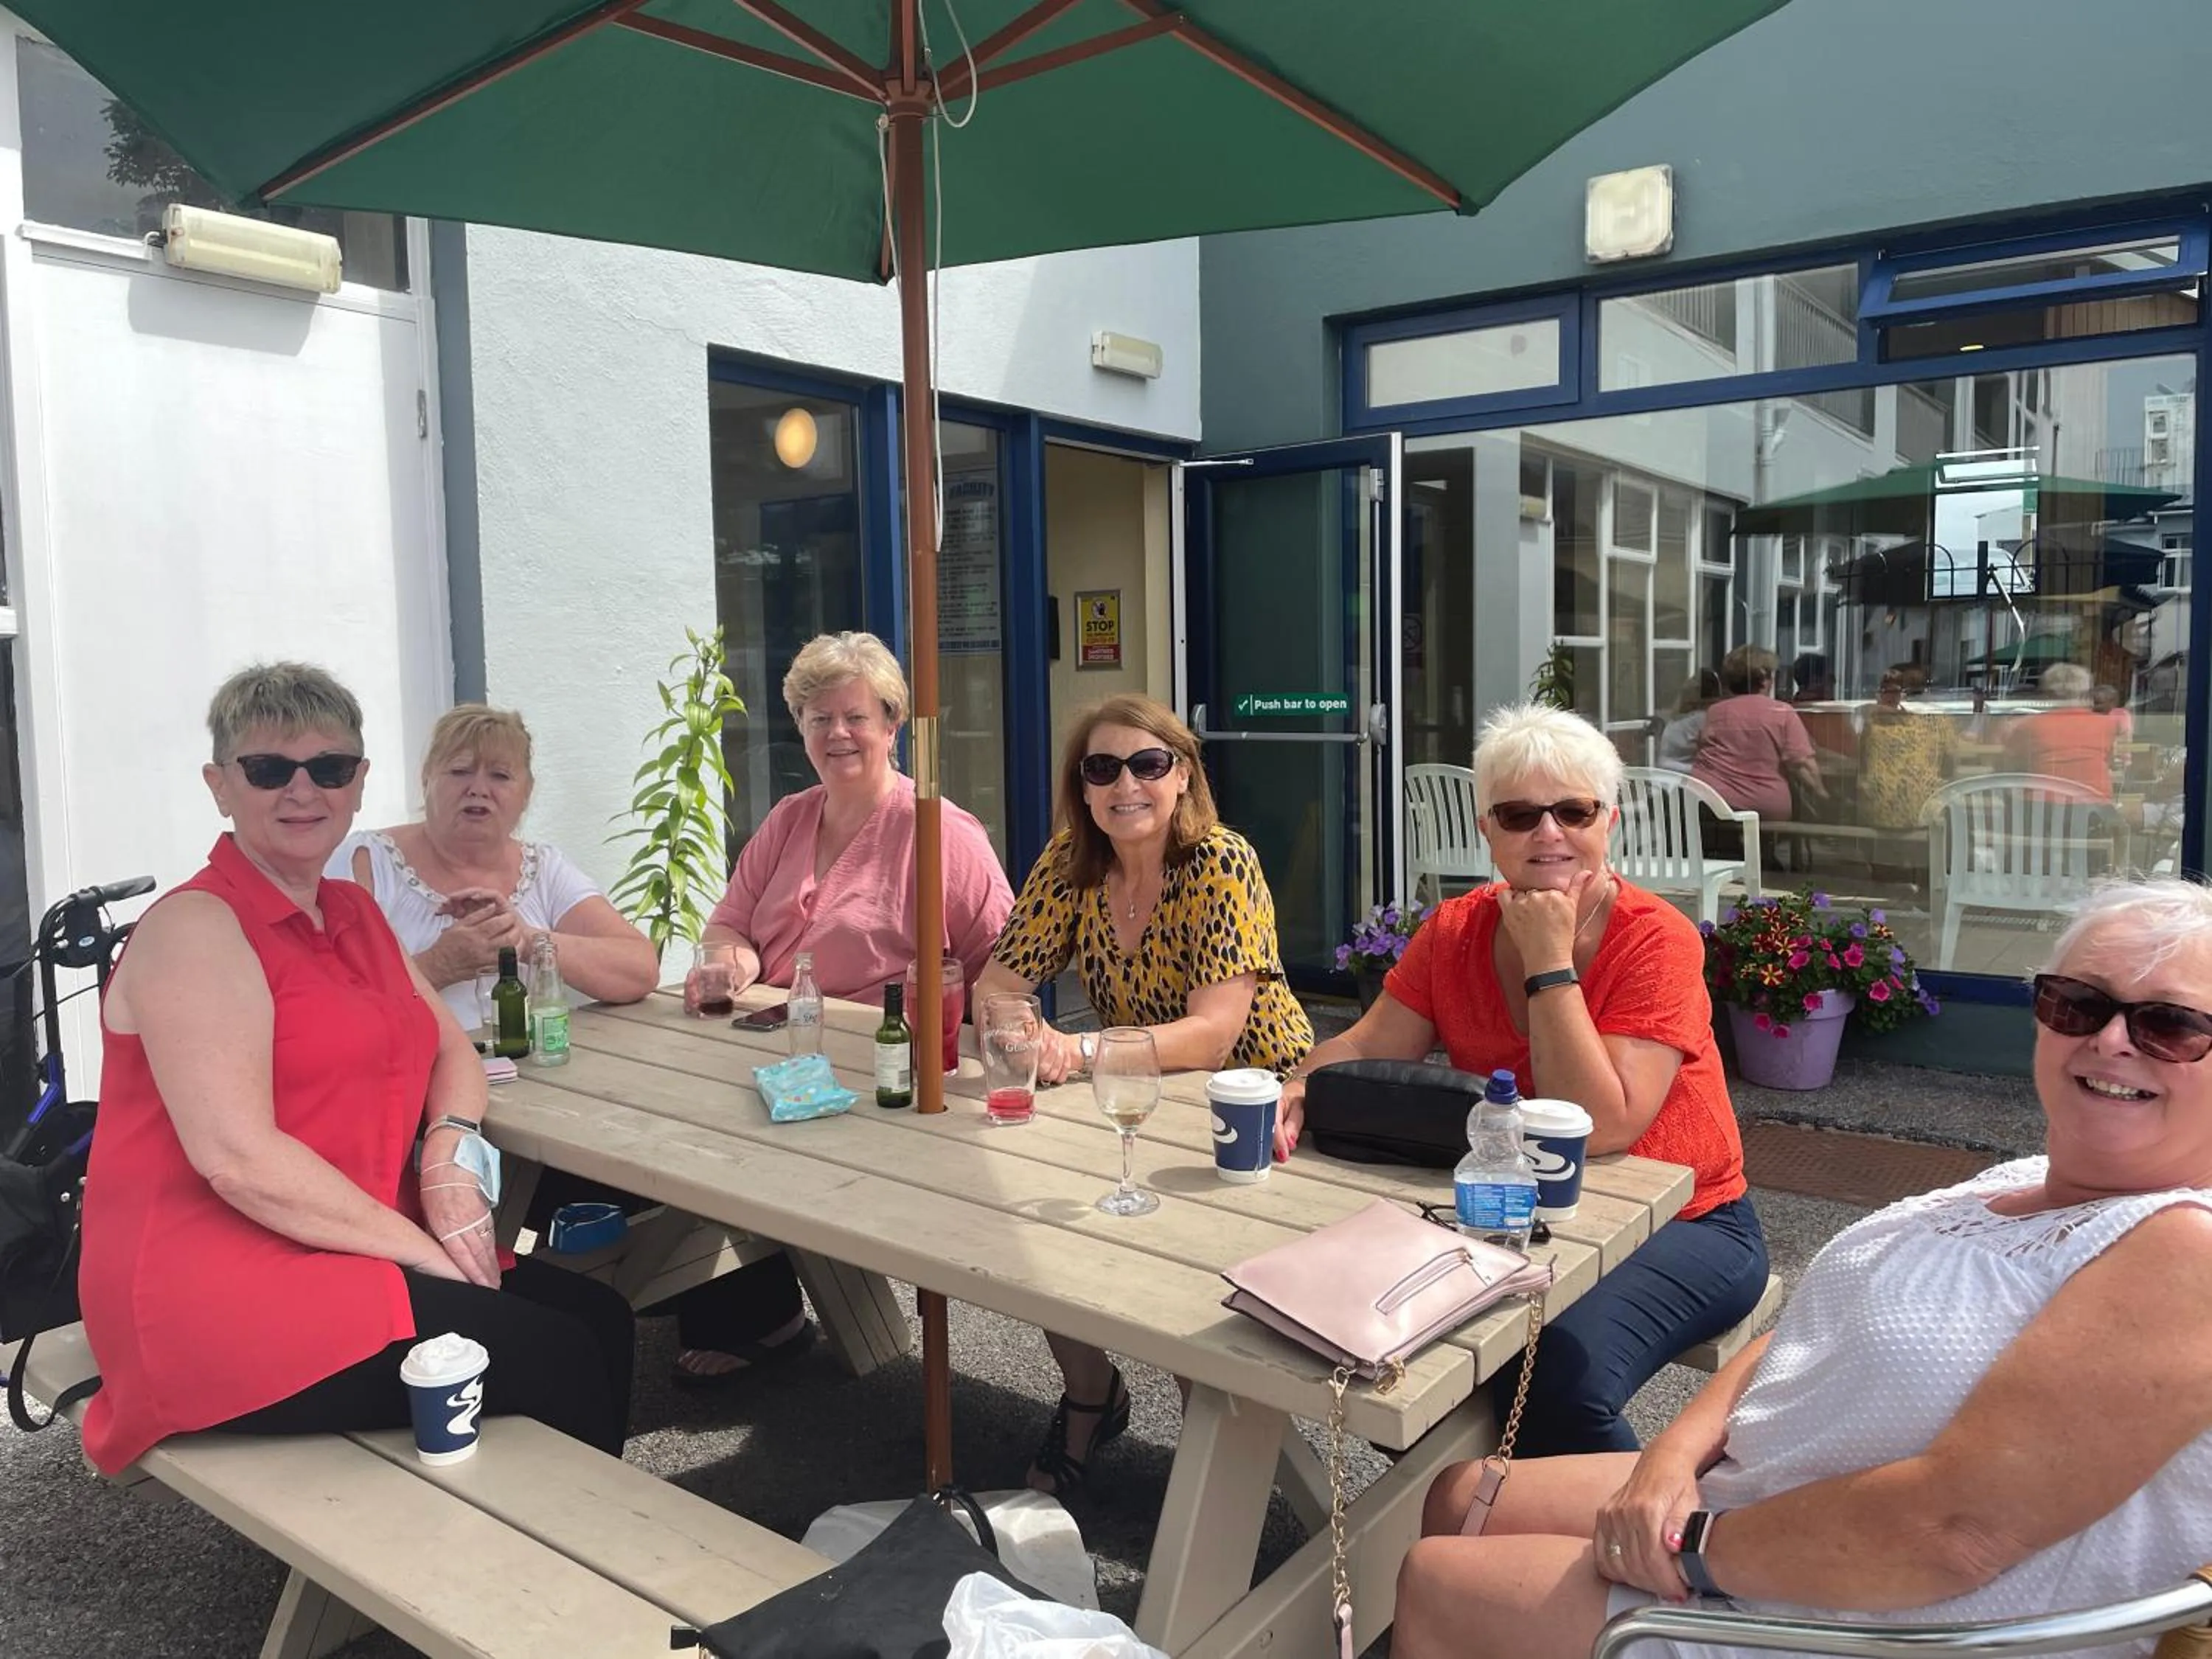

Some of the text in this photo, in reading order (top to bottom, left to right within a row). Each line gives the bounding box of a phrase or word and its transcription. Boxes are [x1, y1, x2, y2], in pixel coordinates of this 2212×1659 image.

[1086, 621, 1114, 631] STOP
[1254, 699, 1347, 712] Push bar to open
